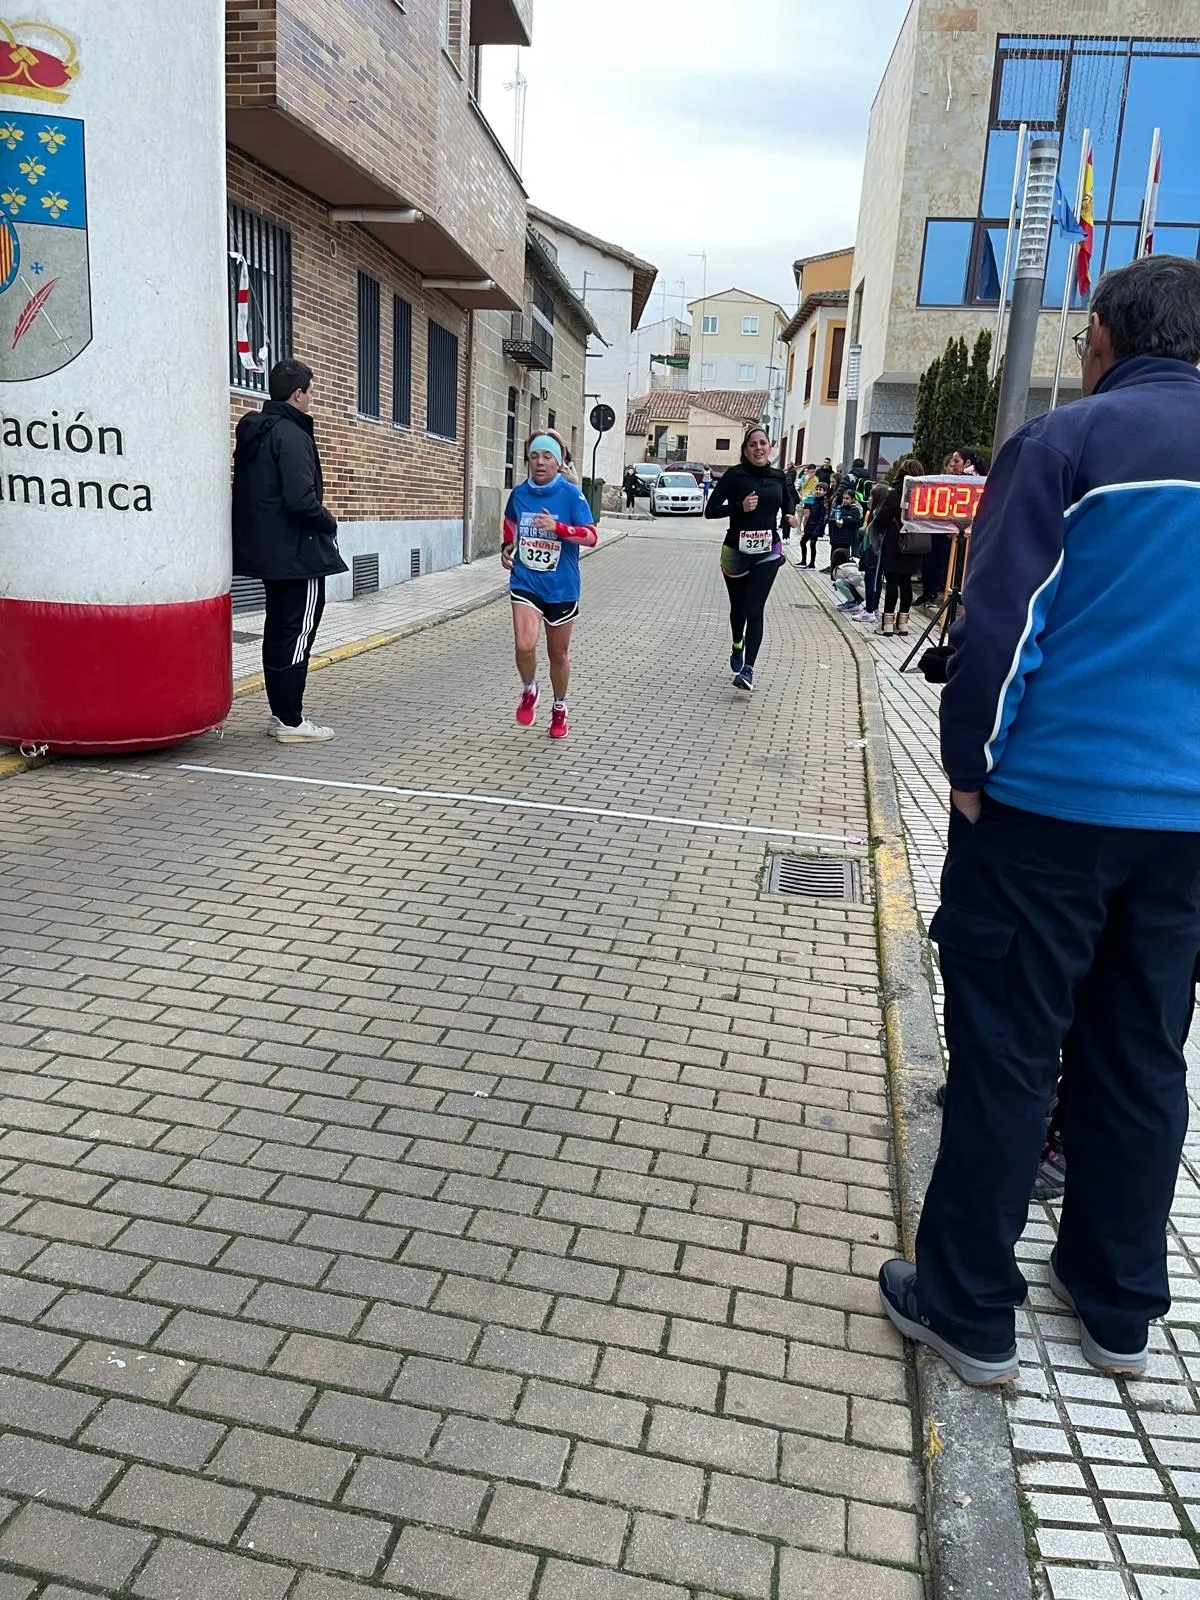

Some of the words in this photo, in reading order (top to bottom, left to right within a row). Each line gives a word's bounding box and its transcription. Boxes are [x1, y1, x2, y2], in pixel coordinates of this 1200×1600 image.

[2, 410, 124, 456] ación
[0, 473, 153, 512] manca
[527, 549, 551, 563] 323
[746, 539, 765, 549] 321
